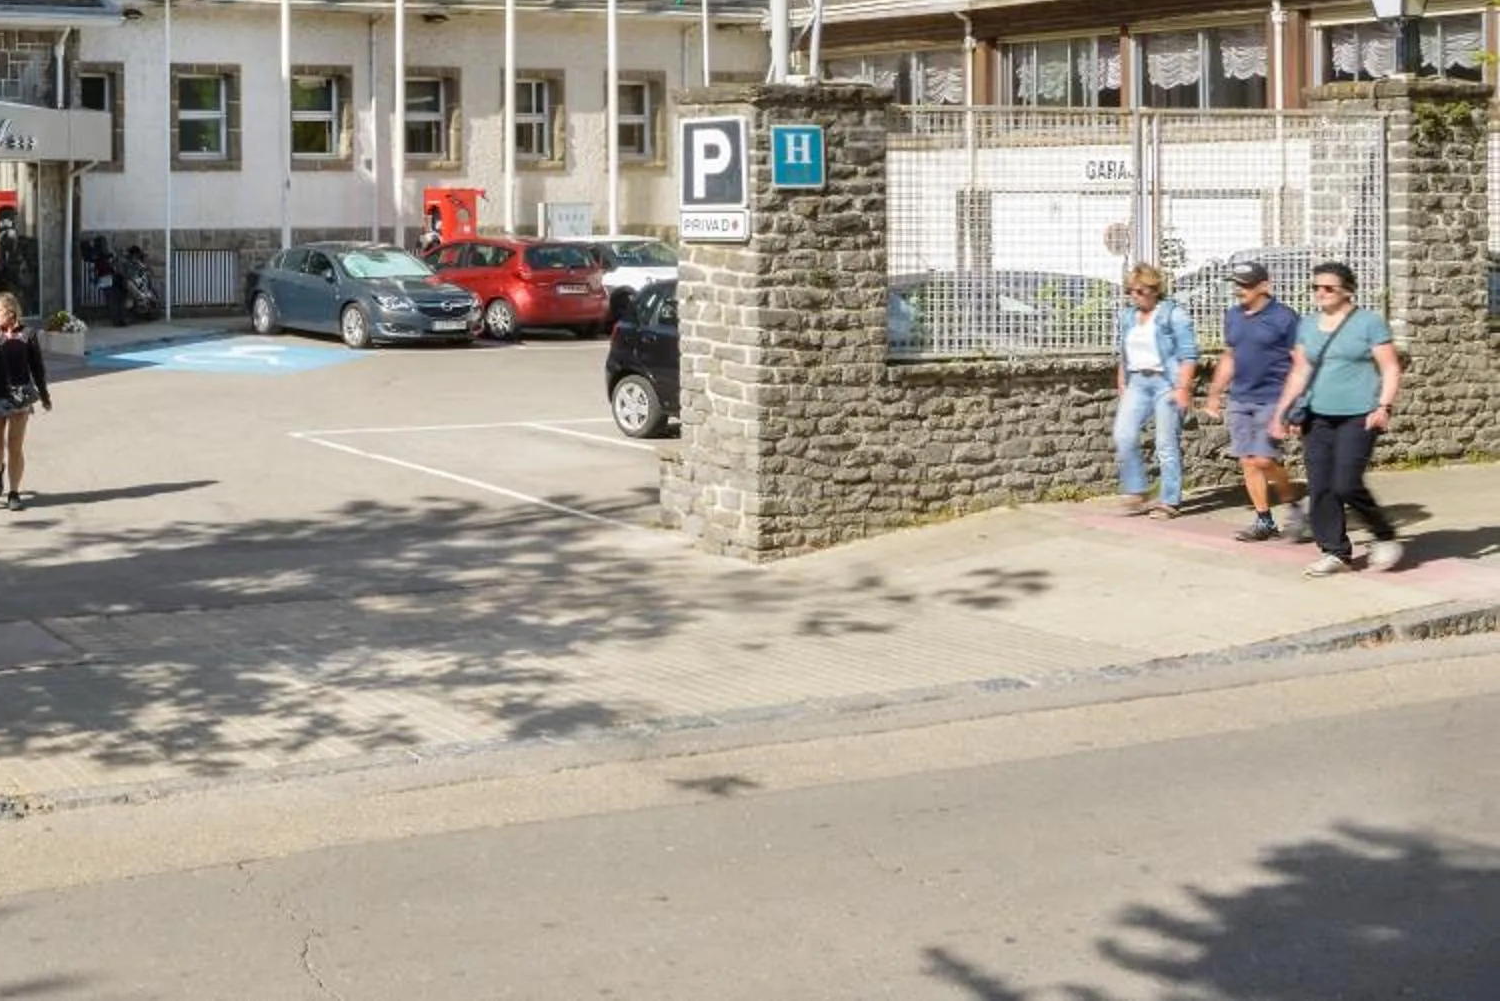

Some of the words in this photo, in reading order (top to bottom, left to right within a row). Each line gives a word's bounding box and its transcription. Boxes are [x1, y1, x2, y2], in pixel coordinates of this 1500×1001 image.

[693, 128, 732, 199] P
[784, 133, 813, 164] H
[1085, 160, 1135, 180] GARA
